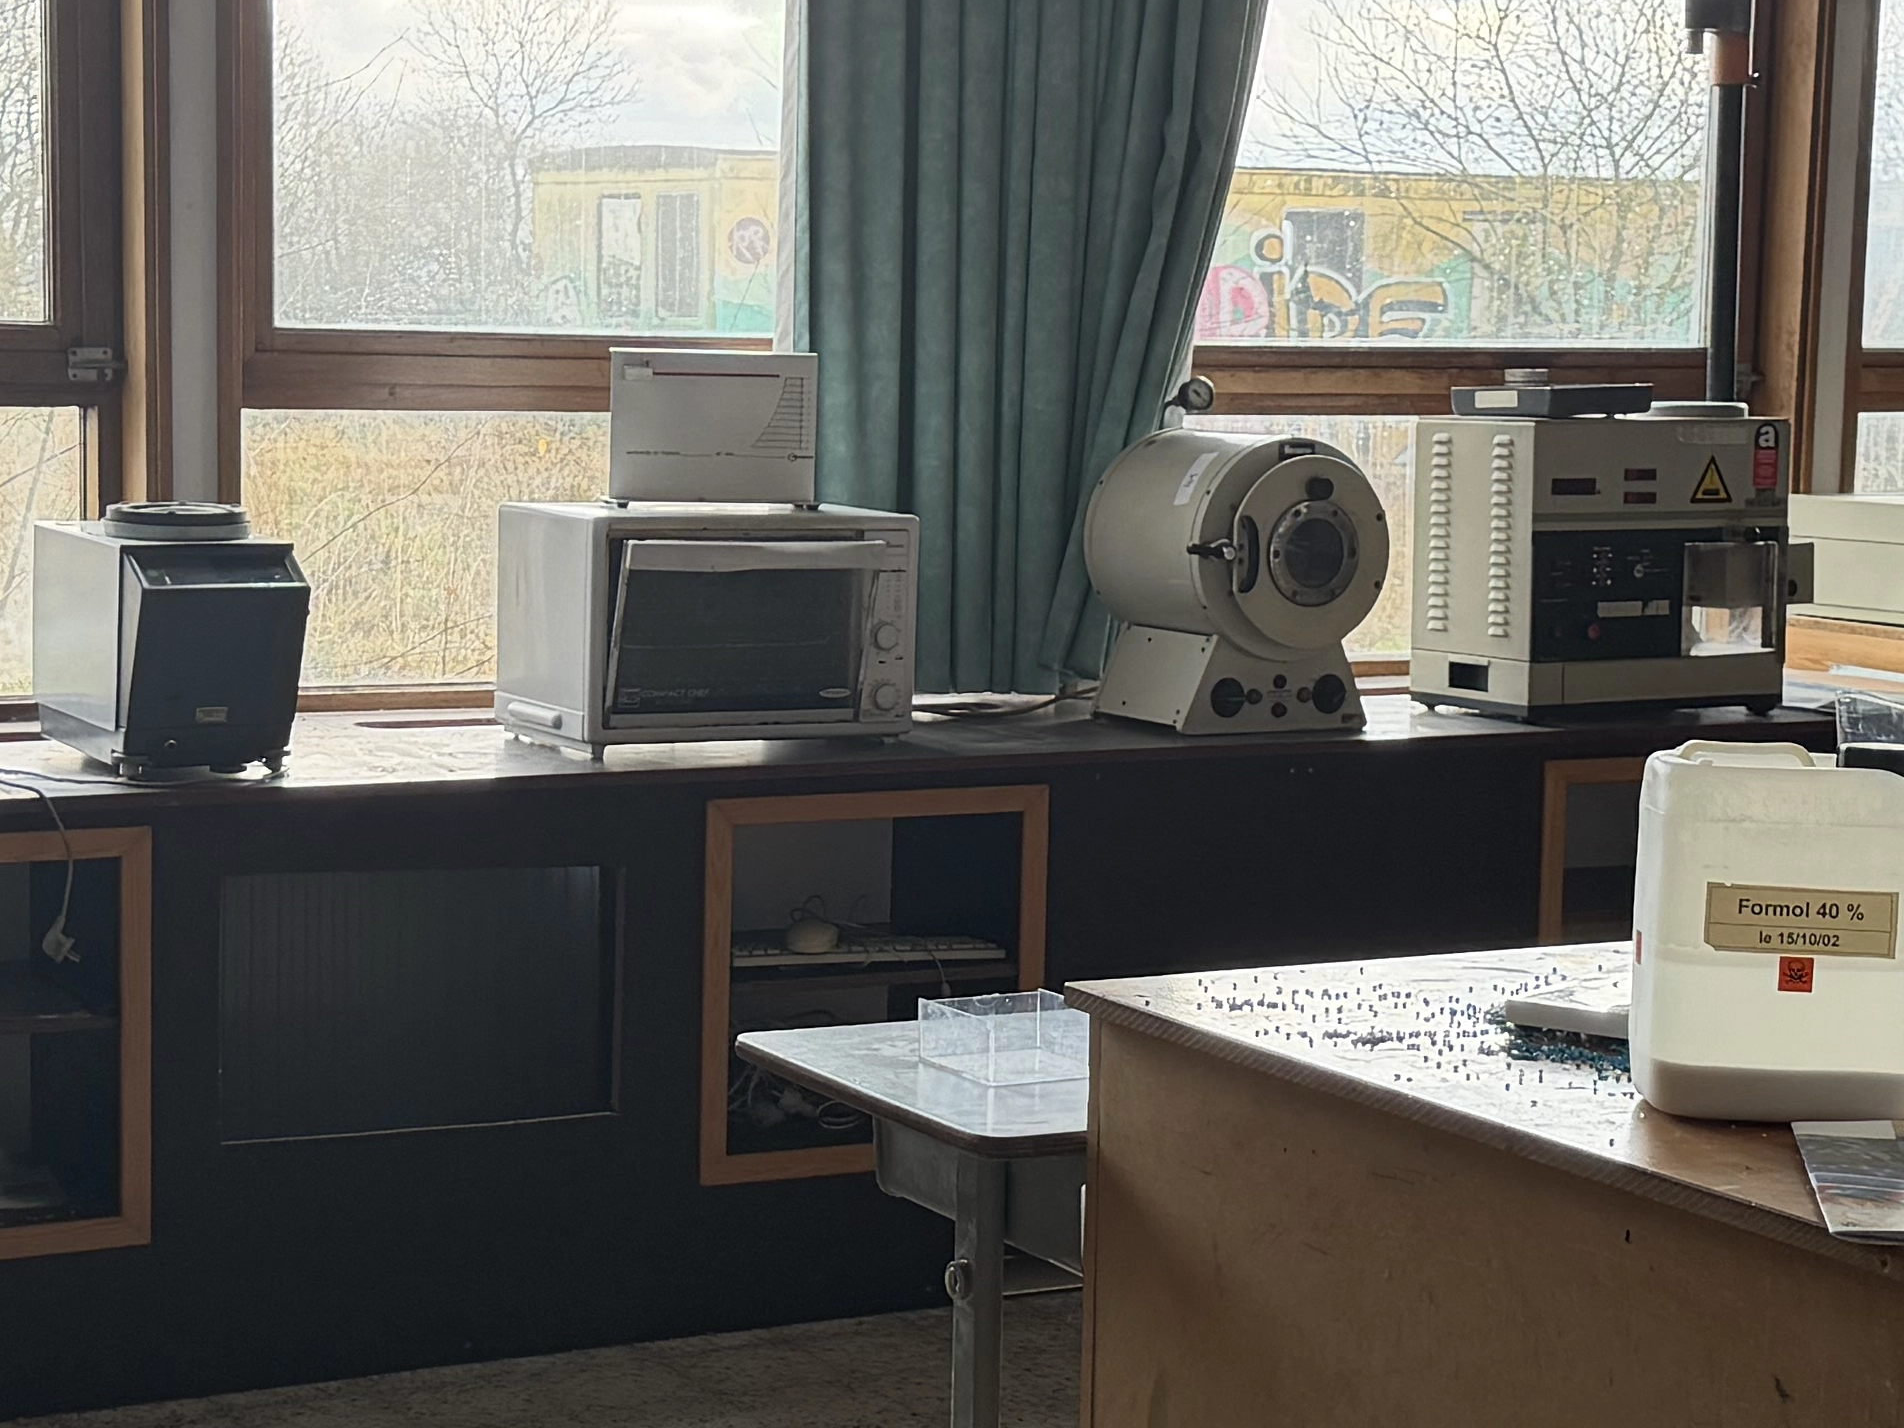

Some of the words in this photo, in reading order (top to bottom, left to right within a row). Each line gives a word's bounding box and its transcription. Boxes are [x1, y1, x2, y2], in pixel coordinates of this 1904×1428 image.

[1737, 897, 1811, 920] Formol
[1816, 901, 1841, 921] 40
[1846, 903, 1865, 922] %
[1777, 931, 1841, 948] 15/10/02
